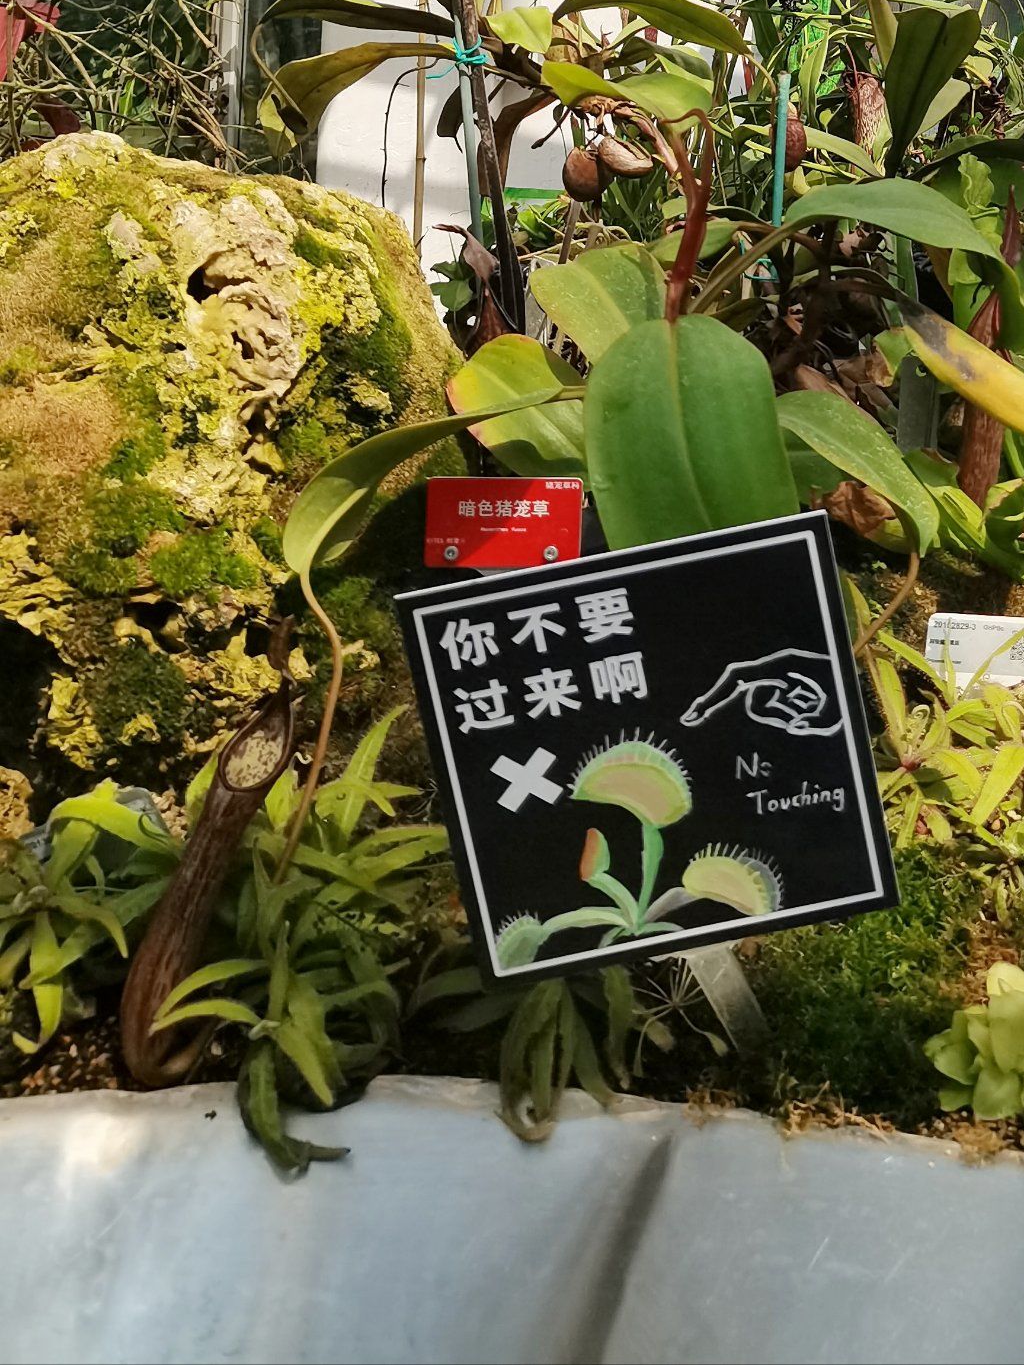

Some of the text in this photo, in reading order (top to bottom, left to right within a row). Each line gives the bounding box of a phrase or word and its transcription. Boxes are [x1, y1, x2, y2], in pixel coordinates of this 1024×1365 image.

[458, 499, 551, 518] 暗色猪笼草
[439, 587, 636, 671] 你不要
[453, 651, 650, 735] 过来啊
[735, 751, 773, 780] No
[745, 780, 846, 815] Touching
